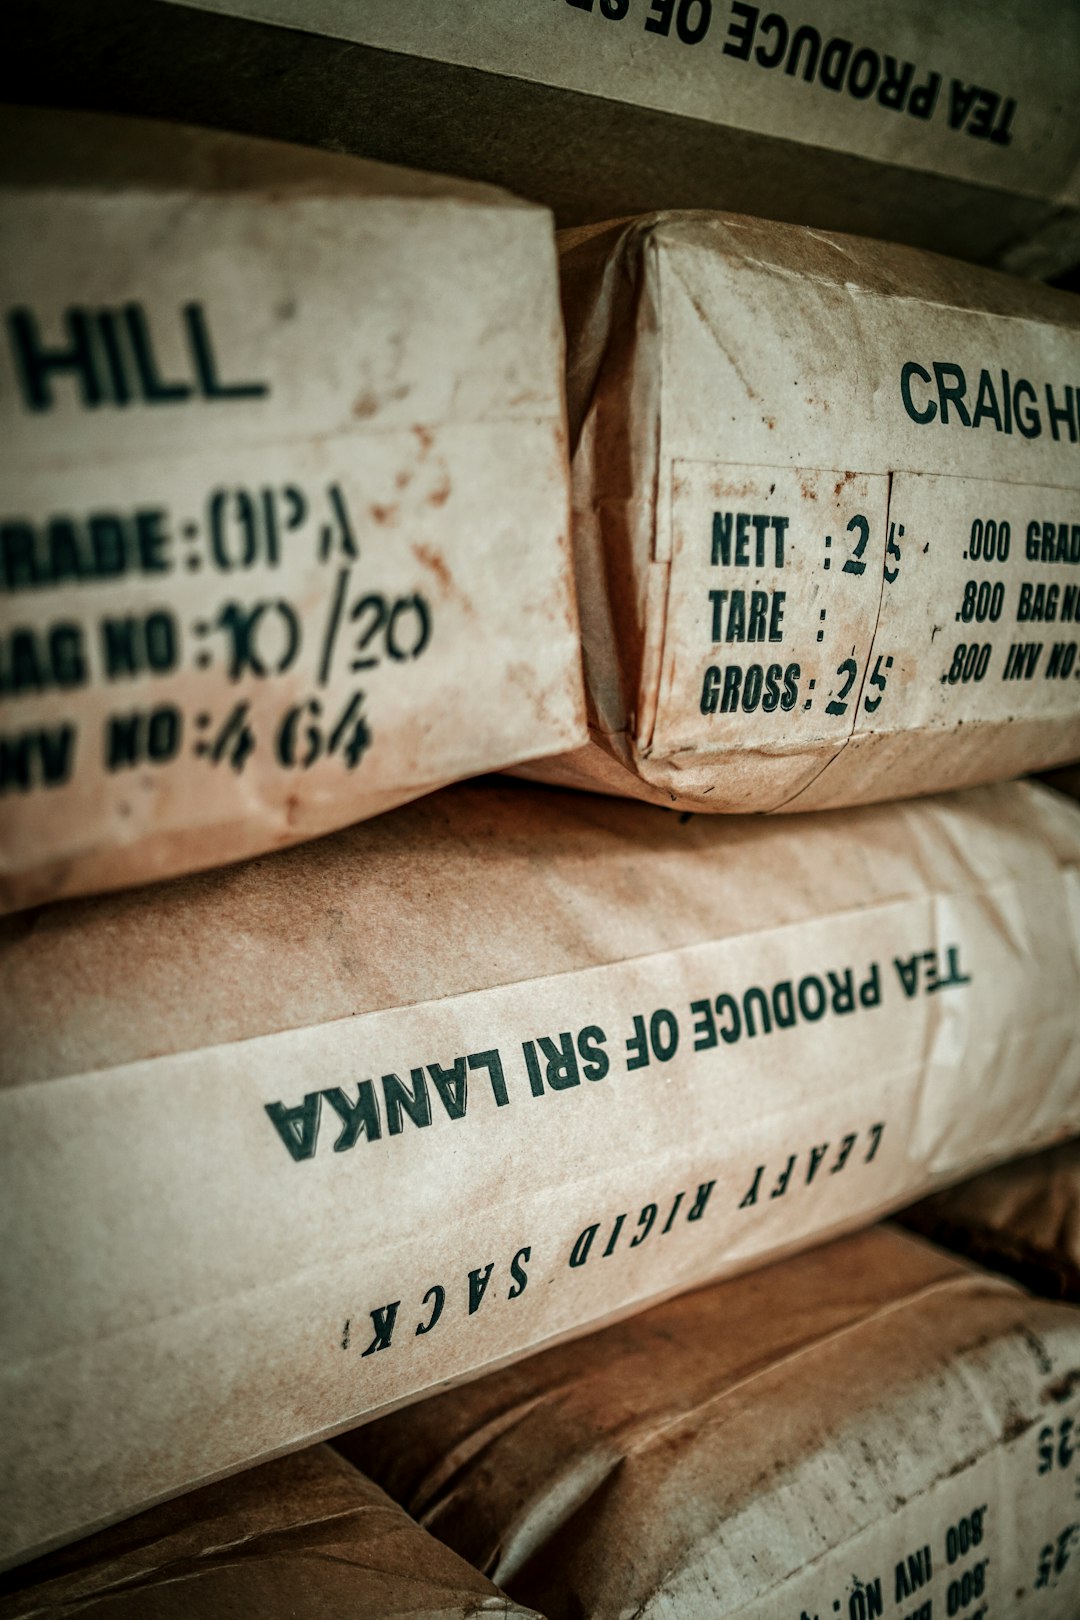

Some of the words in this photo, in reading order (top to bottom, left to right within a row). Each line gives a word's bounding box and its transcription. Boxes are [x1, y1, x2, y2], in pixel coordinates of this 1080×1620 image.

[722, 0, 942, 121] PRODUCE
[948, 77, 1018, 147] TEA
[9, 300, 269, 412] HILL
[901, 361, 1042, 439] CRAIG
[711, 512, 789, 569] NETT
[963, 519, 1011, 563] .000
[708, 590, 787, 643] TARE
[955, 580, 1006, 625] .800
[1016, 582, 1060, 624] BAG
[0, 620, 88, 693] AG
[942, 642, 993, 686] .800
[1002, 642, 1043, 682] INV
[690, 961, 882, 1052] PRODUCE
[893, 945, 971, 999] TEA
[522, 1025, 610, 1098] SRI
[625, 1008, 679, 1072] OF
[264, 1048, 509, 1162] LANKA
[738, 1121, 885, 1209] LEAFY
[569, 1180, 717, 1268] RIGID
[361, 1246, 531, 1358] SACK
[945, 1504, 988, 1565] .800
[894, 1544, 933, 1604] INV
[946, 1558, 990, 1617] .800
